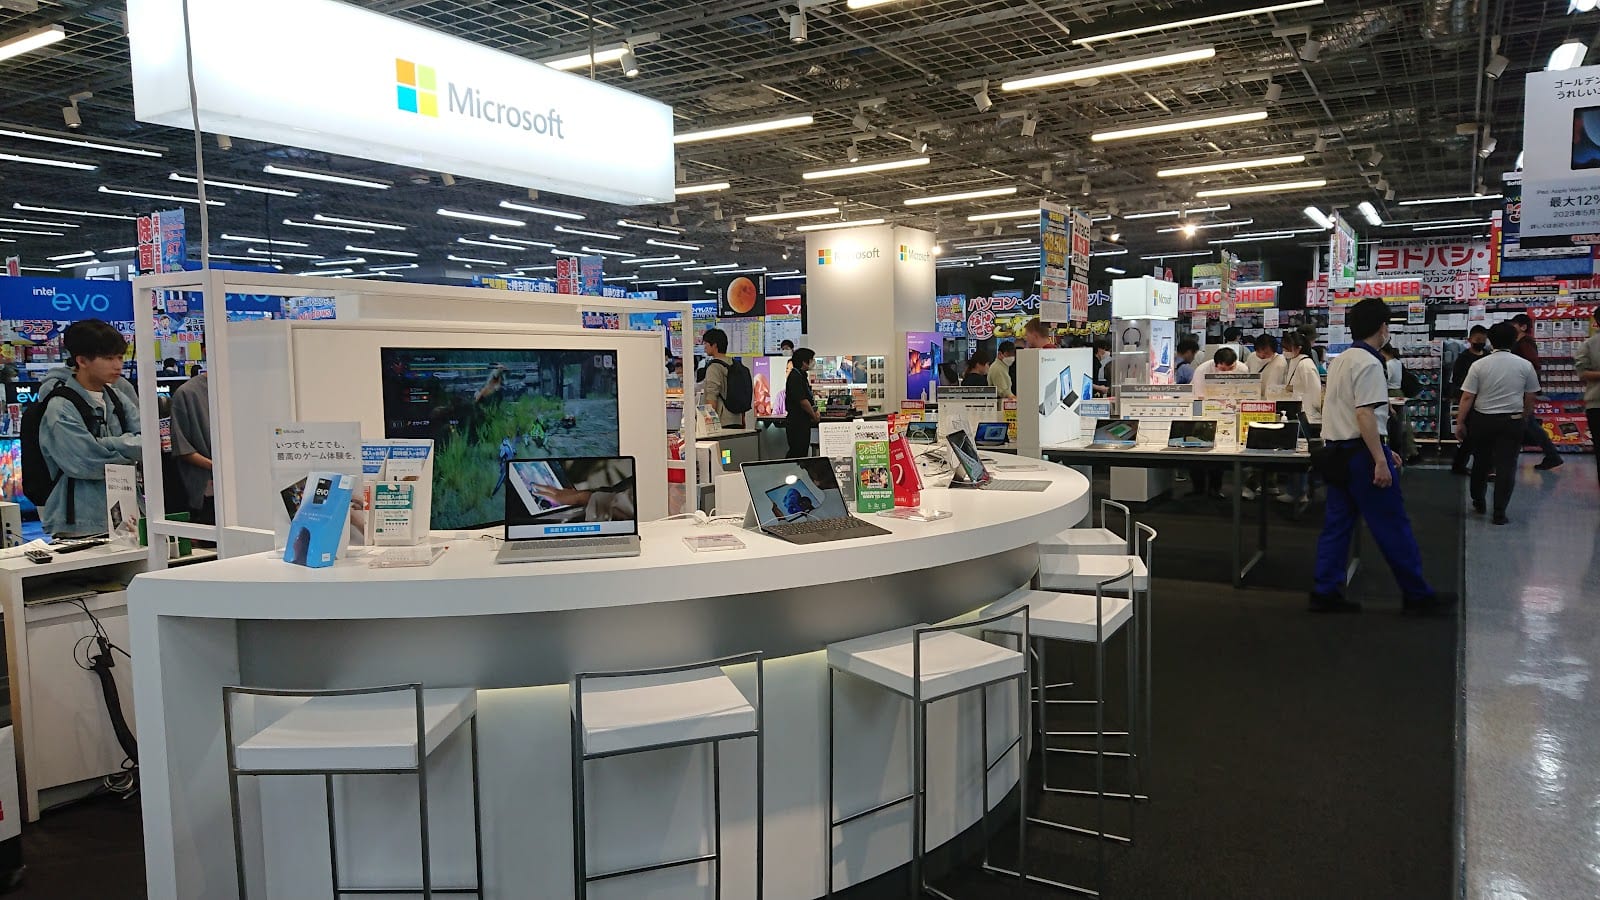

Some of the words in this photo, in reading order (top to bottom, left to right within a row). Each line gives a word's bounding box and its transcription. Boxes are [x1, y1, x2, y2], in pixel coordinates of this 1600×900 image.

[448, 82, 564, 139] Microsoft
[834, 247, 880, 262] Mosoft
[33, 287, 56, 296] intel
[1212, 287, 1275, 304] CSHIER
[1308, 290, 1314, 303] 2
[1319, 290, 1325, 304] 2
[1352, 281, 1421, 298] CASHIER
[1457, 283, 1464, 298] 3
[1469, 282, 1476, 297] 3
[52, 293, 110, 312] evo
[276, 441, 345, 449] いつでもどこでも、
[277, 452, 356, 461] 最高のゲーム体験を。
[316, 488, 329, 496] evo
